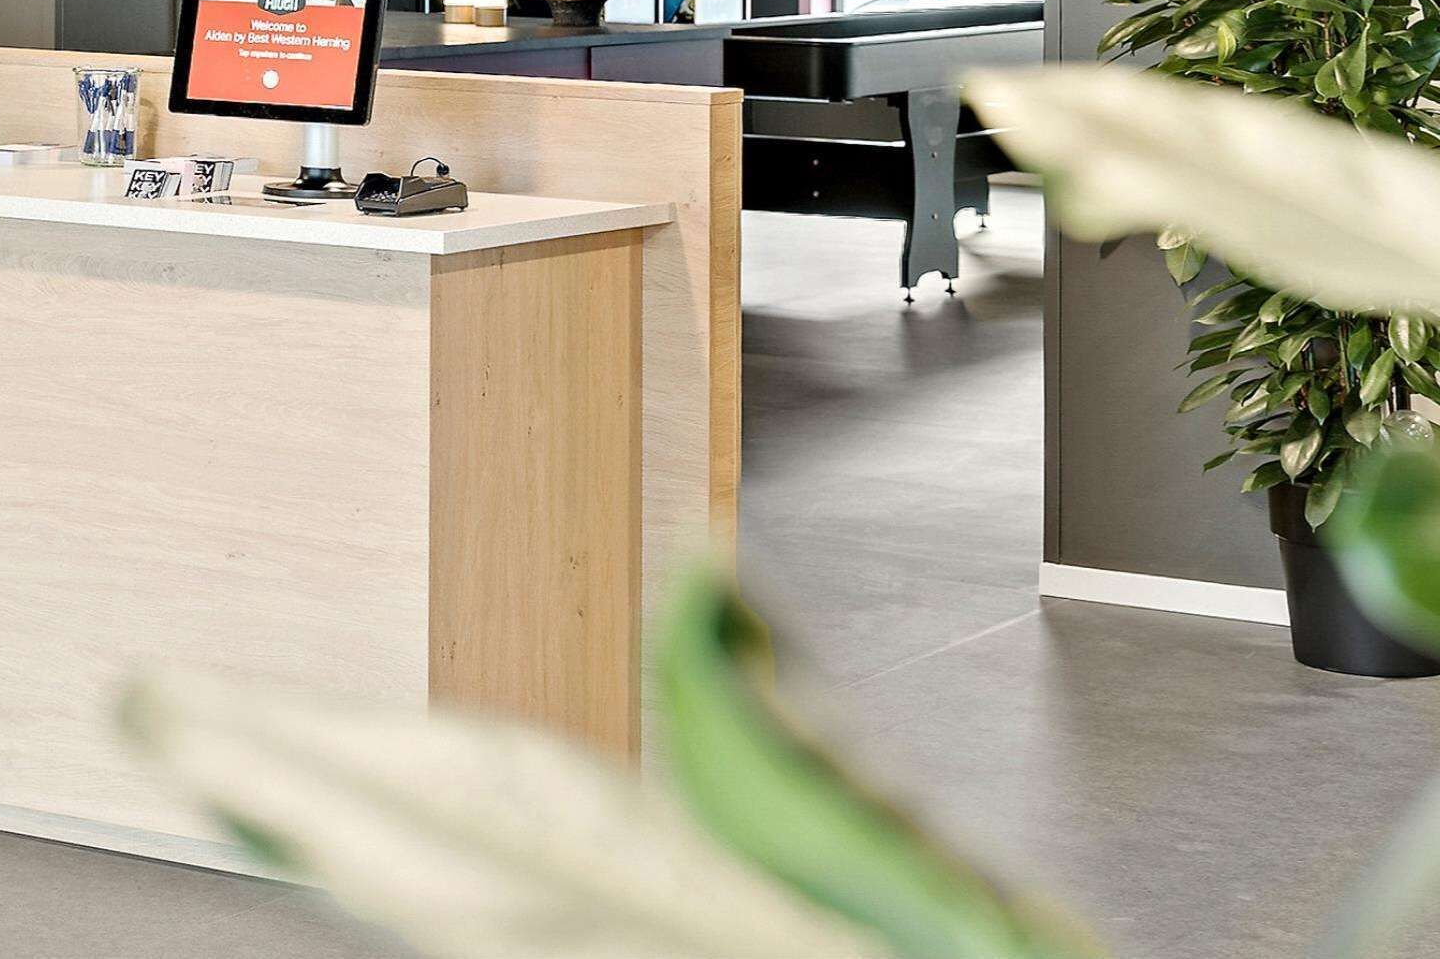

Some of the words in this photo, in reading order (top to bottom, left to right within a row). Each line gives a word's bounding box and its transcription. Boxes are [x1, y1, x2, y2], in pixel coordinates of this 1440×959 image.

[251, 19, 295, 32] Welcome
[296, 22, 307, 33] to
[205, 29, 233, 42] Aiden
[234, 31, 246, 44] by
[247, 32, 270, 44] Best
[271, 34, 310, 47] Western
[193, 163, 214, 174] EY
[133, 170, 165, 181] KEY
[130, 181, 161, 191] KY
